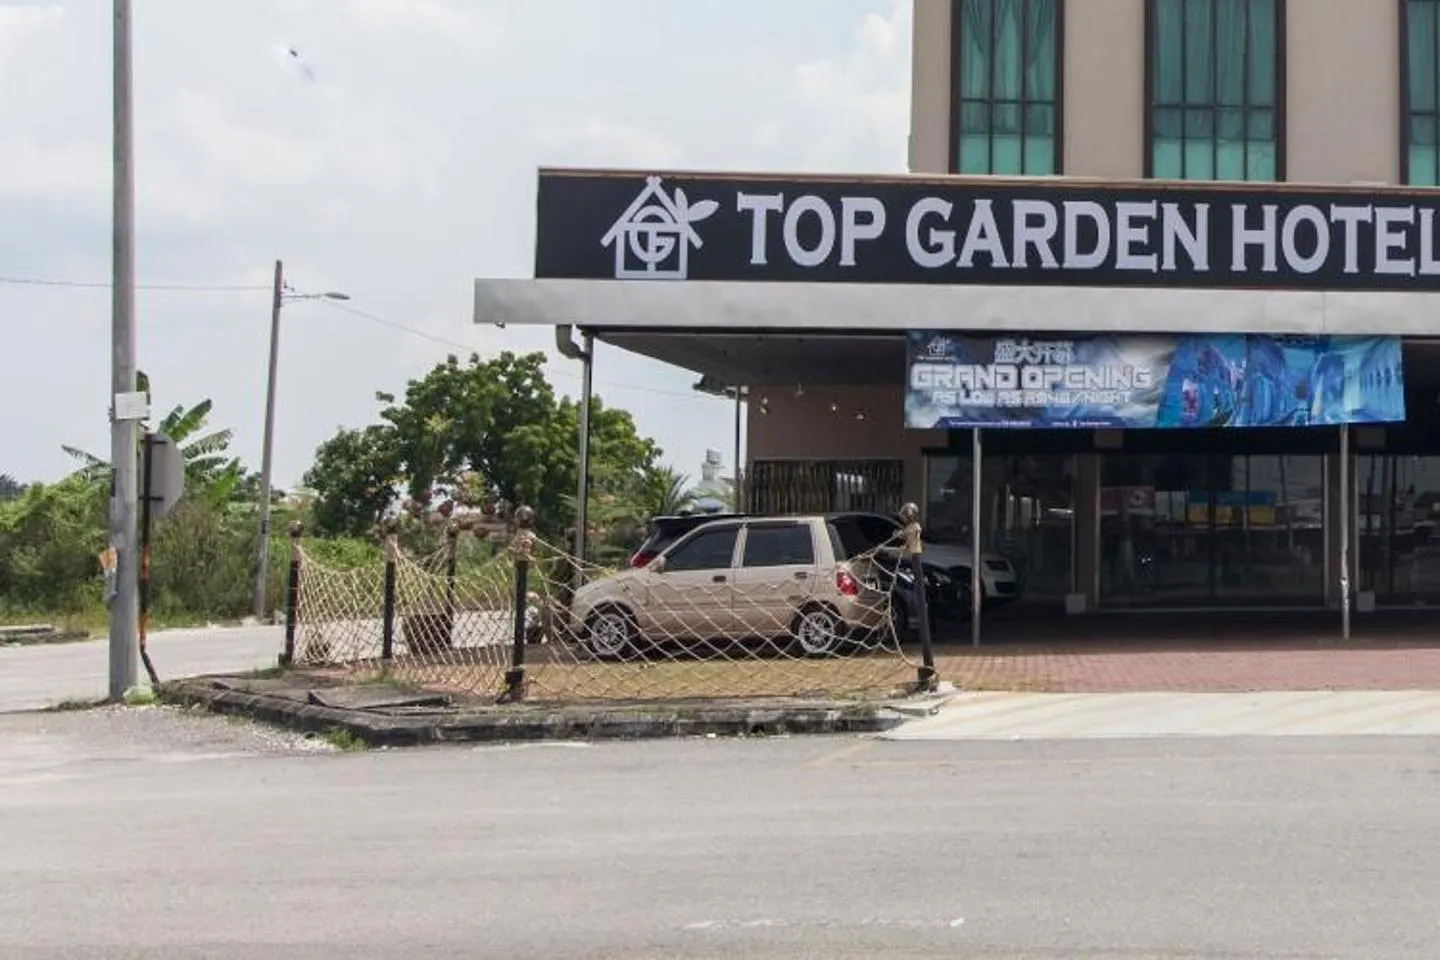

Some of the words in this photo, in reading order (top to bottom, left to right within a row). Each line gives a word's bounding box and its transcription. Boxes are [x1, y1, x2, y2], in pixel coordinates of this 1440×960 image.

[736, 191, 887, 268] TOP
[905, 196, 1210, 273] GARDEN
[910, 362, 1020, 391] GRAND
[1021, 364, 1152, 391] OPENING
